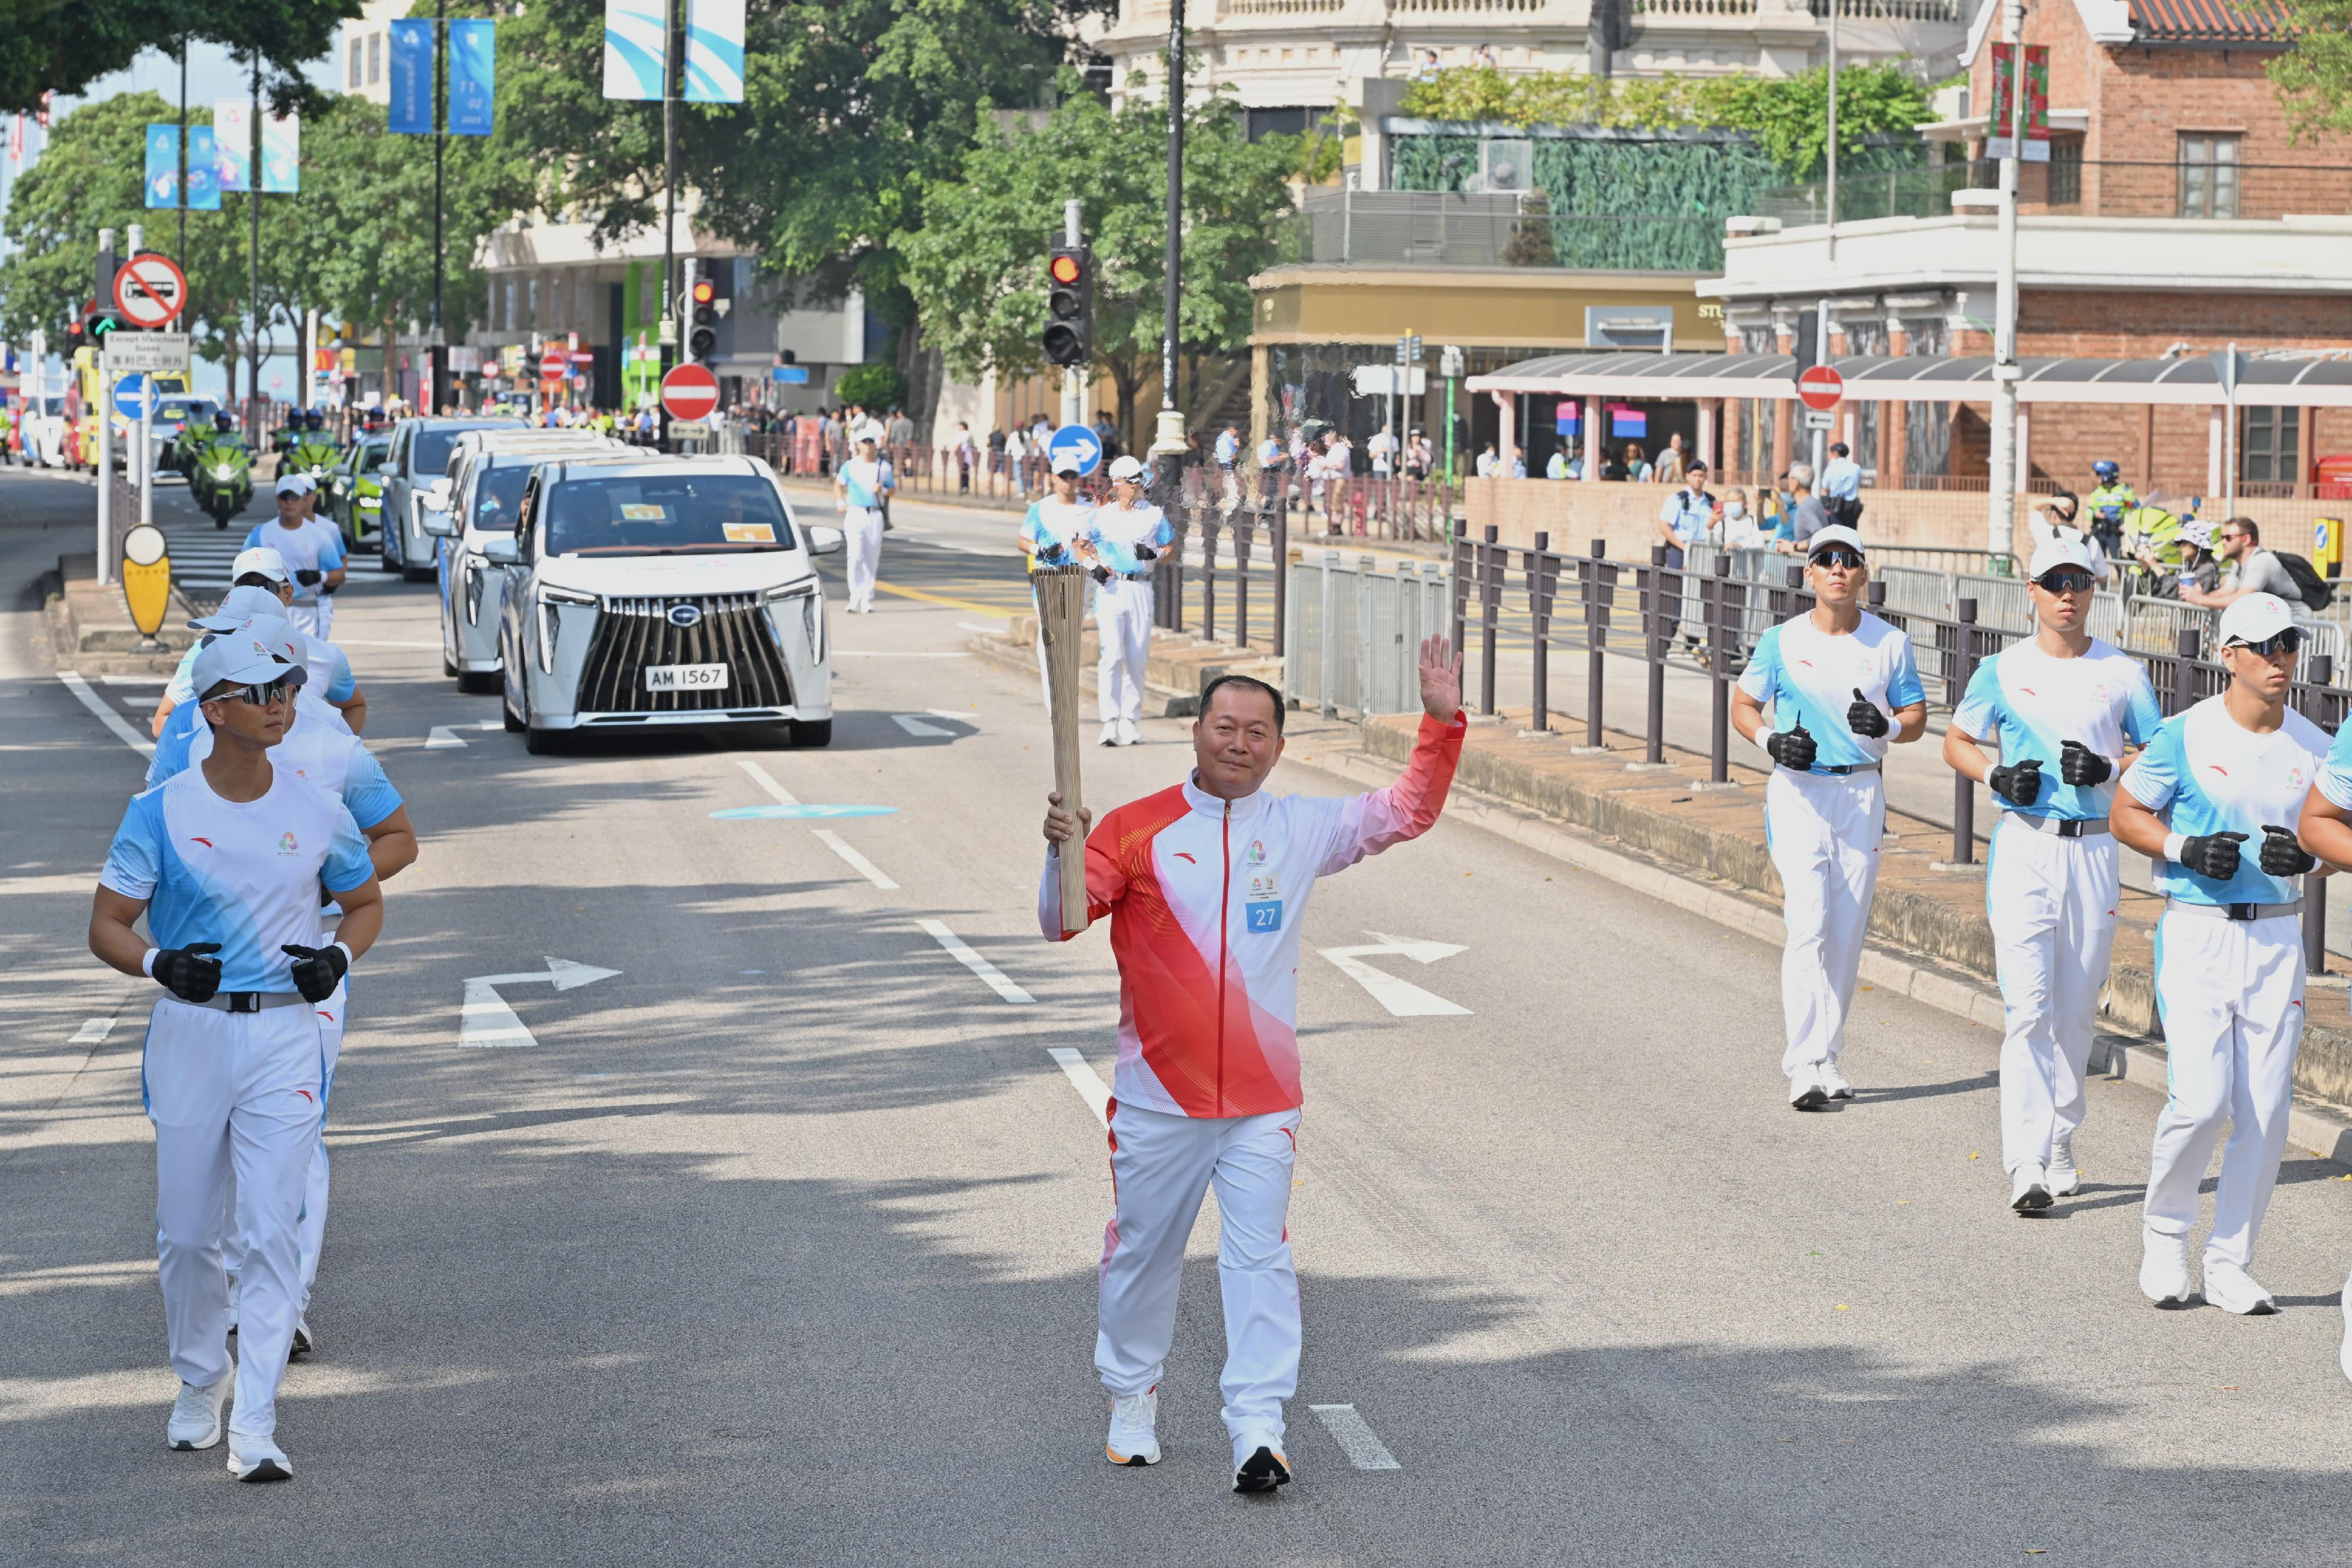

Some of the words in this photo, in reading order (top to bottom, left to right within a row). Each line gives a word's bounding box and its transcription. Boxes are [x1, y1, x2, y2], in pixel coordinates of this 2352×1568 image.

[109, 335, 139, 343] Except
[142, 335, 184, 343] franchised
[652, 672, 674, 685] AM
[683, 670, 720, 684] 1567
[1255, 908, 1275, 927] 27
